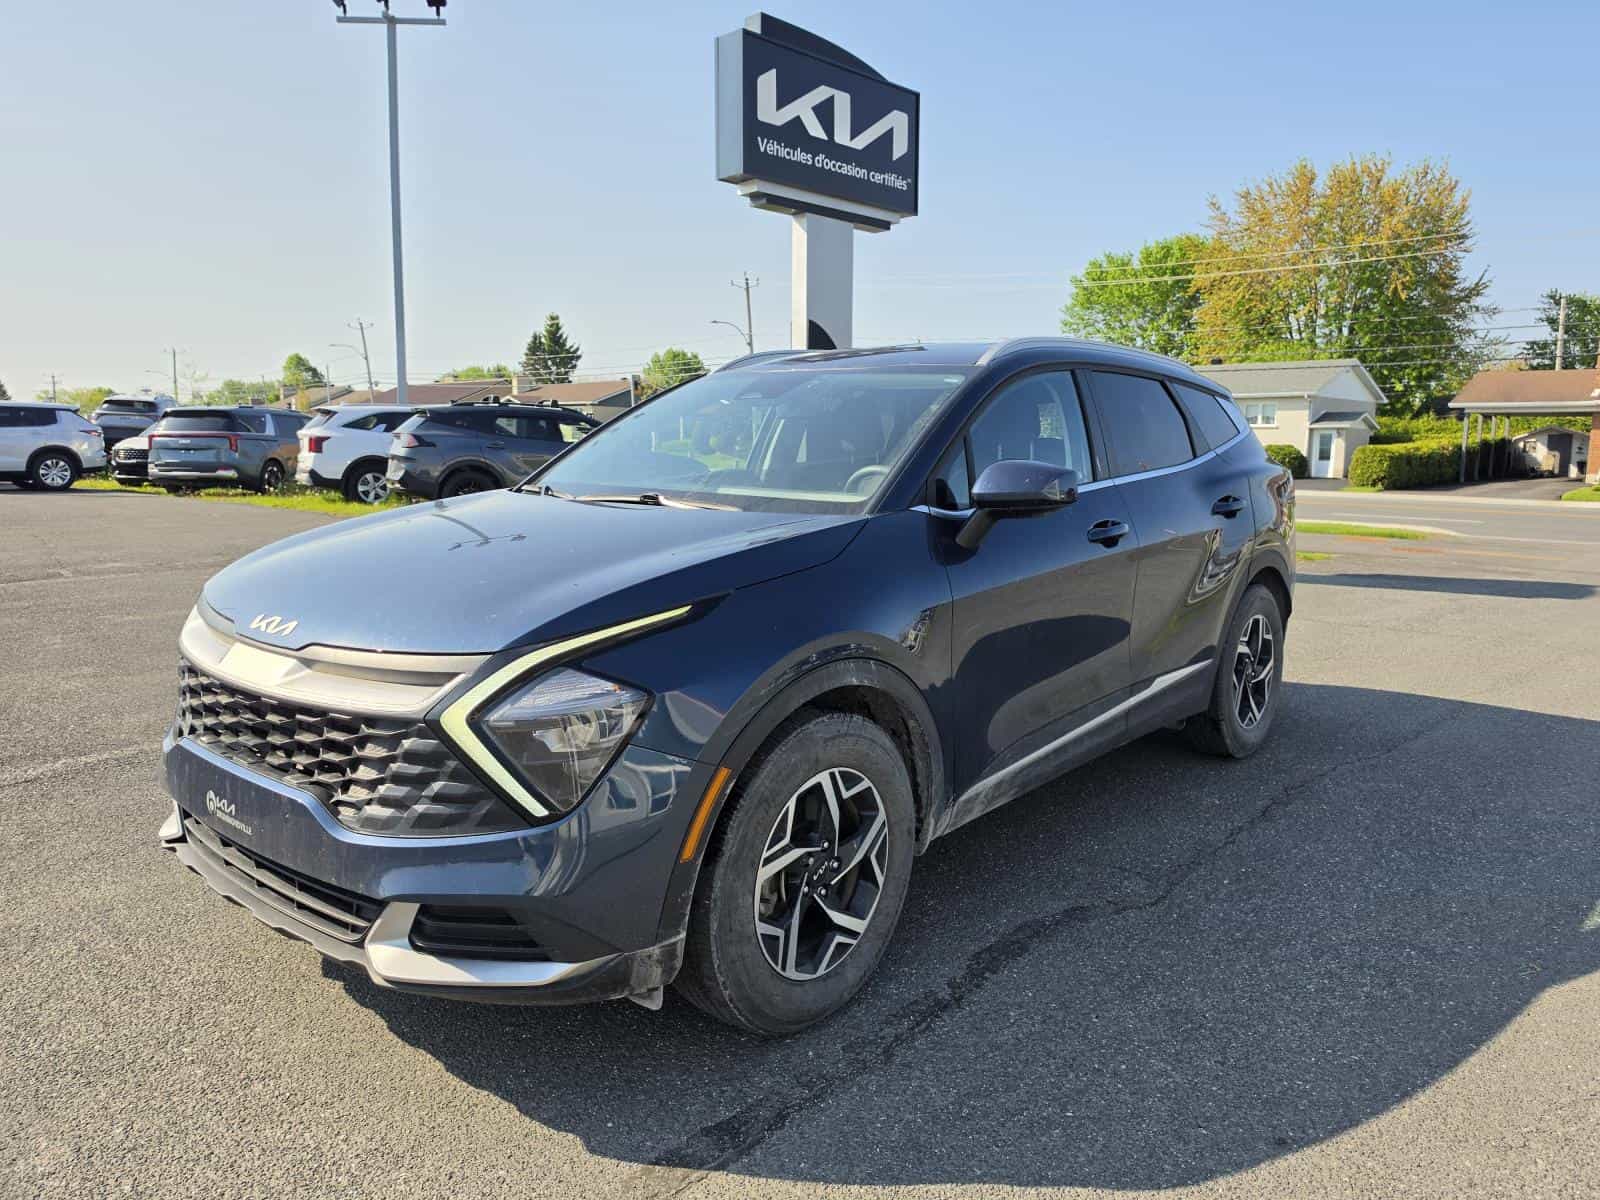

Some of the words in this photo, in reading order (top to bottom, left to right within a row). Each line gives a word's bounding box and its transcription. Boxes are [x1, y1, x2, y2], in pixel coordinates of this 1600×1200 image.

[756, 68, 909, 161] KIA
[757, 136, 813, 165] Véhicules
[815, 153, 868, 180] d'occasion
[869, 171, 908, 191] certifiés
[250, 614, 299, 637] KIA
[216, 795, 236, 816] KIA
